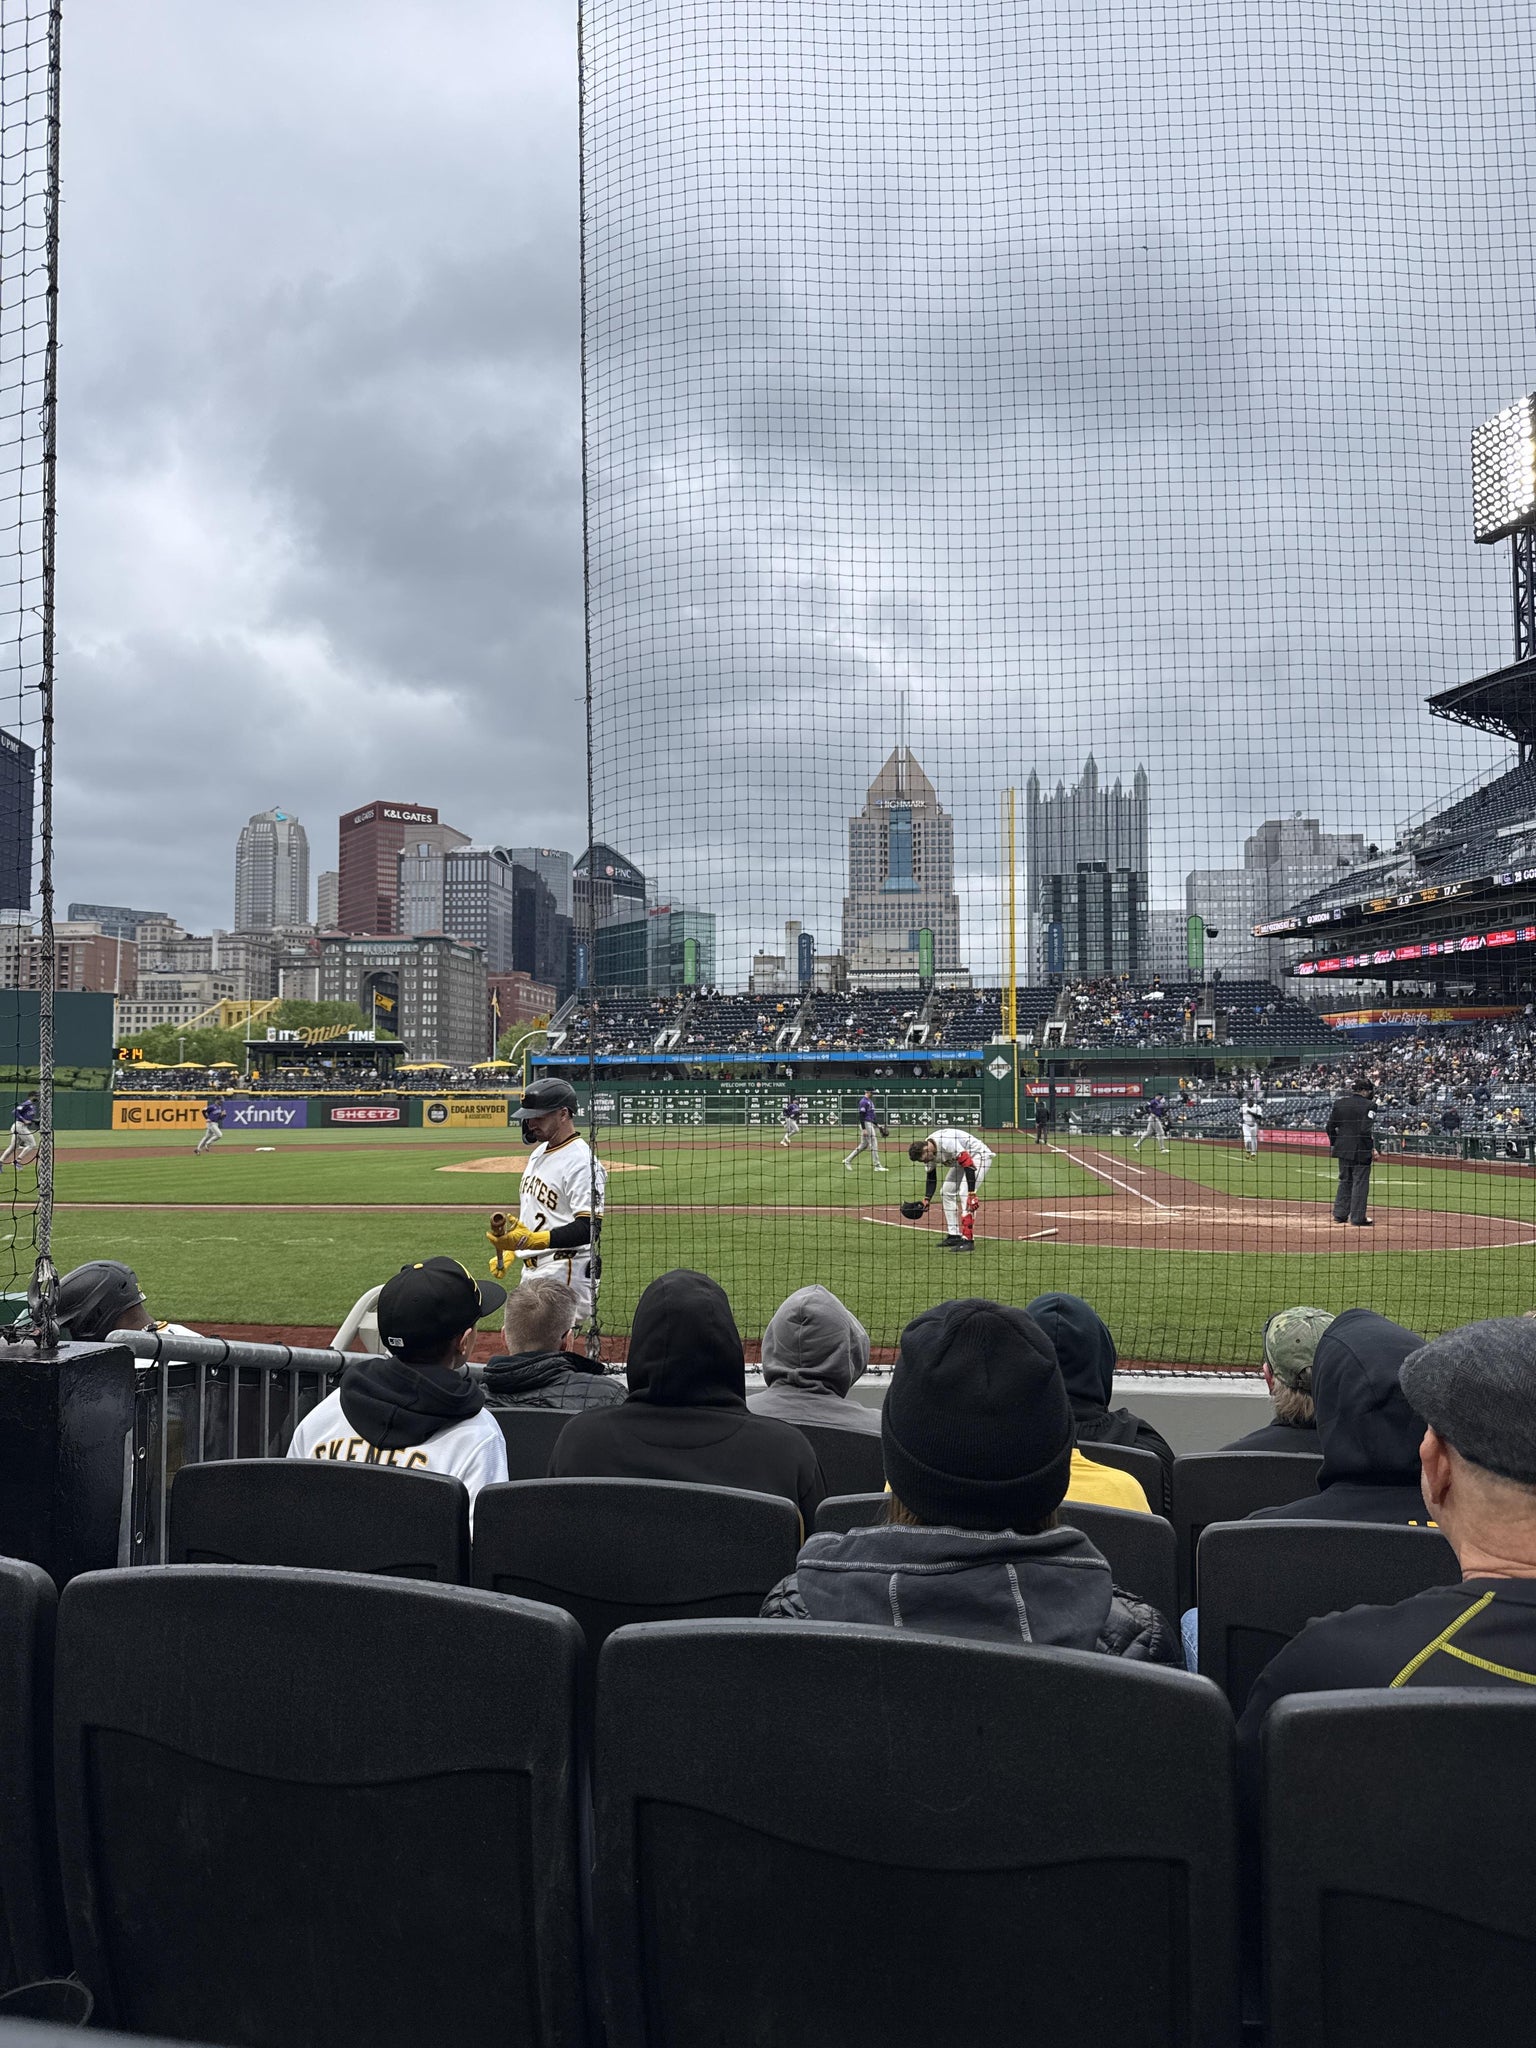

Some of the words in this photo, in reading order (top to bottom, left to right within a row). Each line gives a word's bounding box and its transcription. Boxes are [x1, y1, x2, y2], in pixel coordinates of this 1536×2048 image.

[383, 808, 402, 819] K&L
[402, 811, 433, 823] GATES
[615, 867, 632, 879] PNC
[1379, 1011, 1428, 1026] Surfside
[279, 1029, 300, 1041] IT'S
[298, 1023, 357, 1049] Miller
[347, 1030, 376, 1041] TIME
[119, 1047, 143, 1060] 2:14
[121, 1107, 142, 1123] IC
[145, 1108, 200, 1122] LIGHT
[233, 1105, 296, 1125] xfinity
[336, 1109, 396, 1119] SHEETZ
[451, 1105, 476, 1114] EDGAR
[476, 1105, 506, 1114] SNYDER
[520, 1175, 558, 1211] RATES
[534, 1212, 546, 1232] 2
